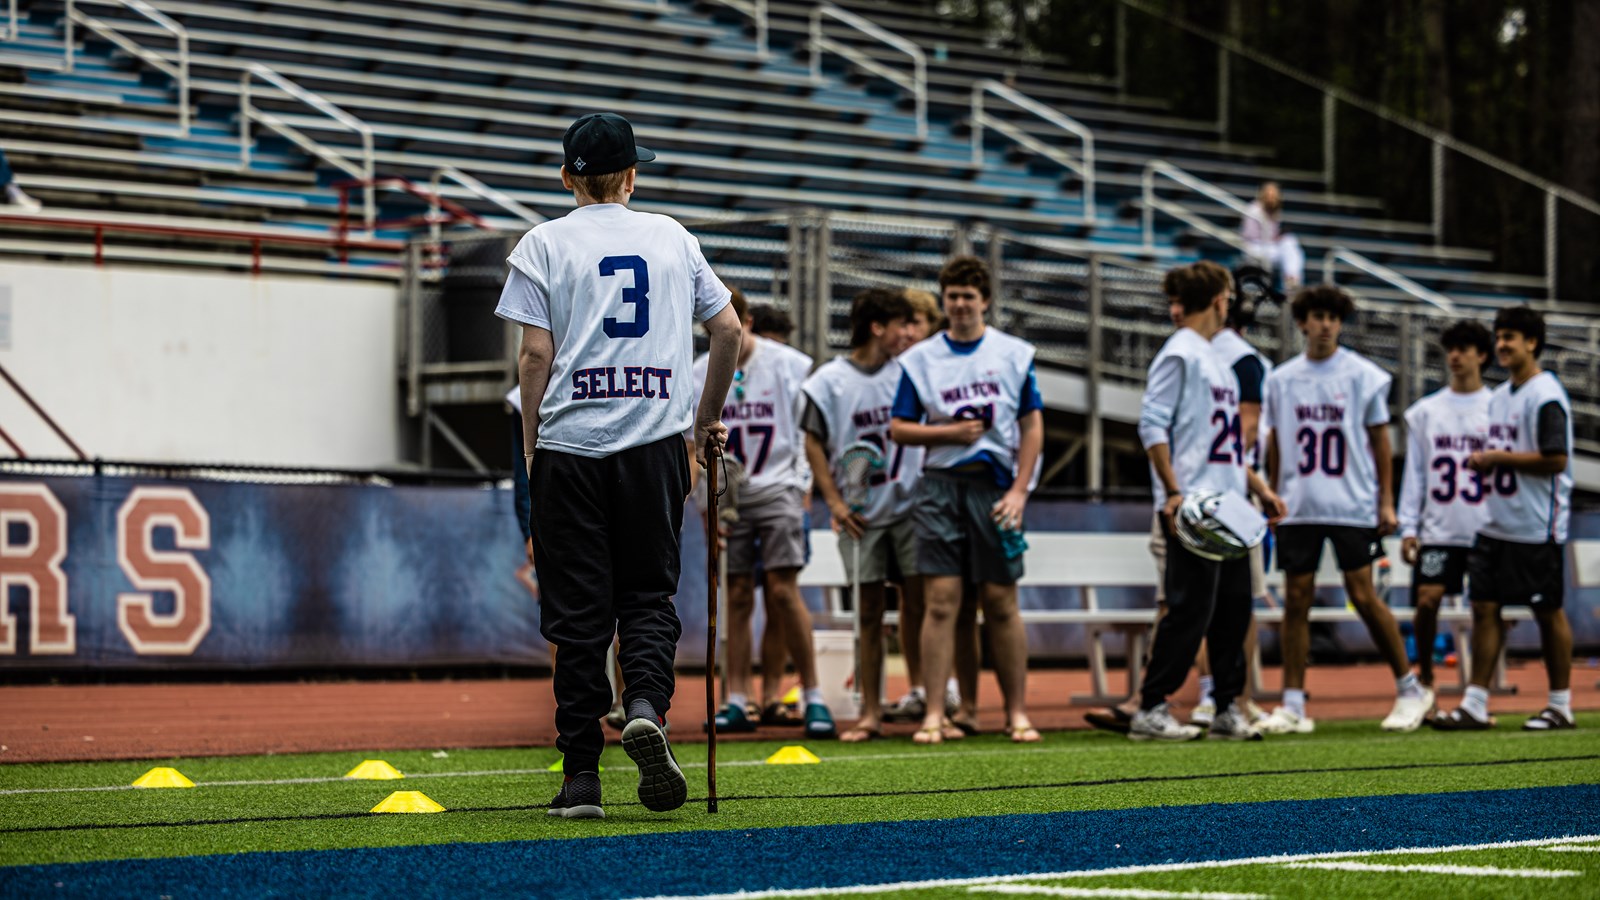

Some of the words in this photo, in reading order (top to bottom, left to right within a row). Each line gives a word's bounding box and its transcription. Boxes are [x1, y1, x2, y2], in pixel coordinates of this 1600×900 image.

[597, 254, 650, 339] 3
[571, 366, 672, 400] SELECT
[1295, 404, 1345, 422] WALTON
[1296, 424, 1346, 479] 30
[1431, 455, 1485, 505] 33
